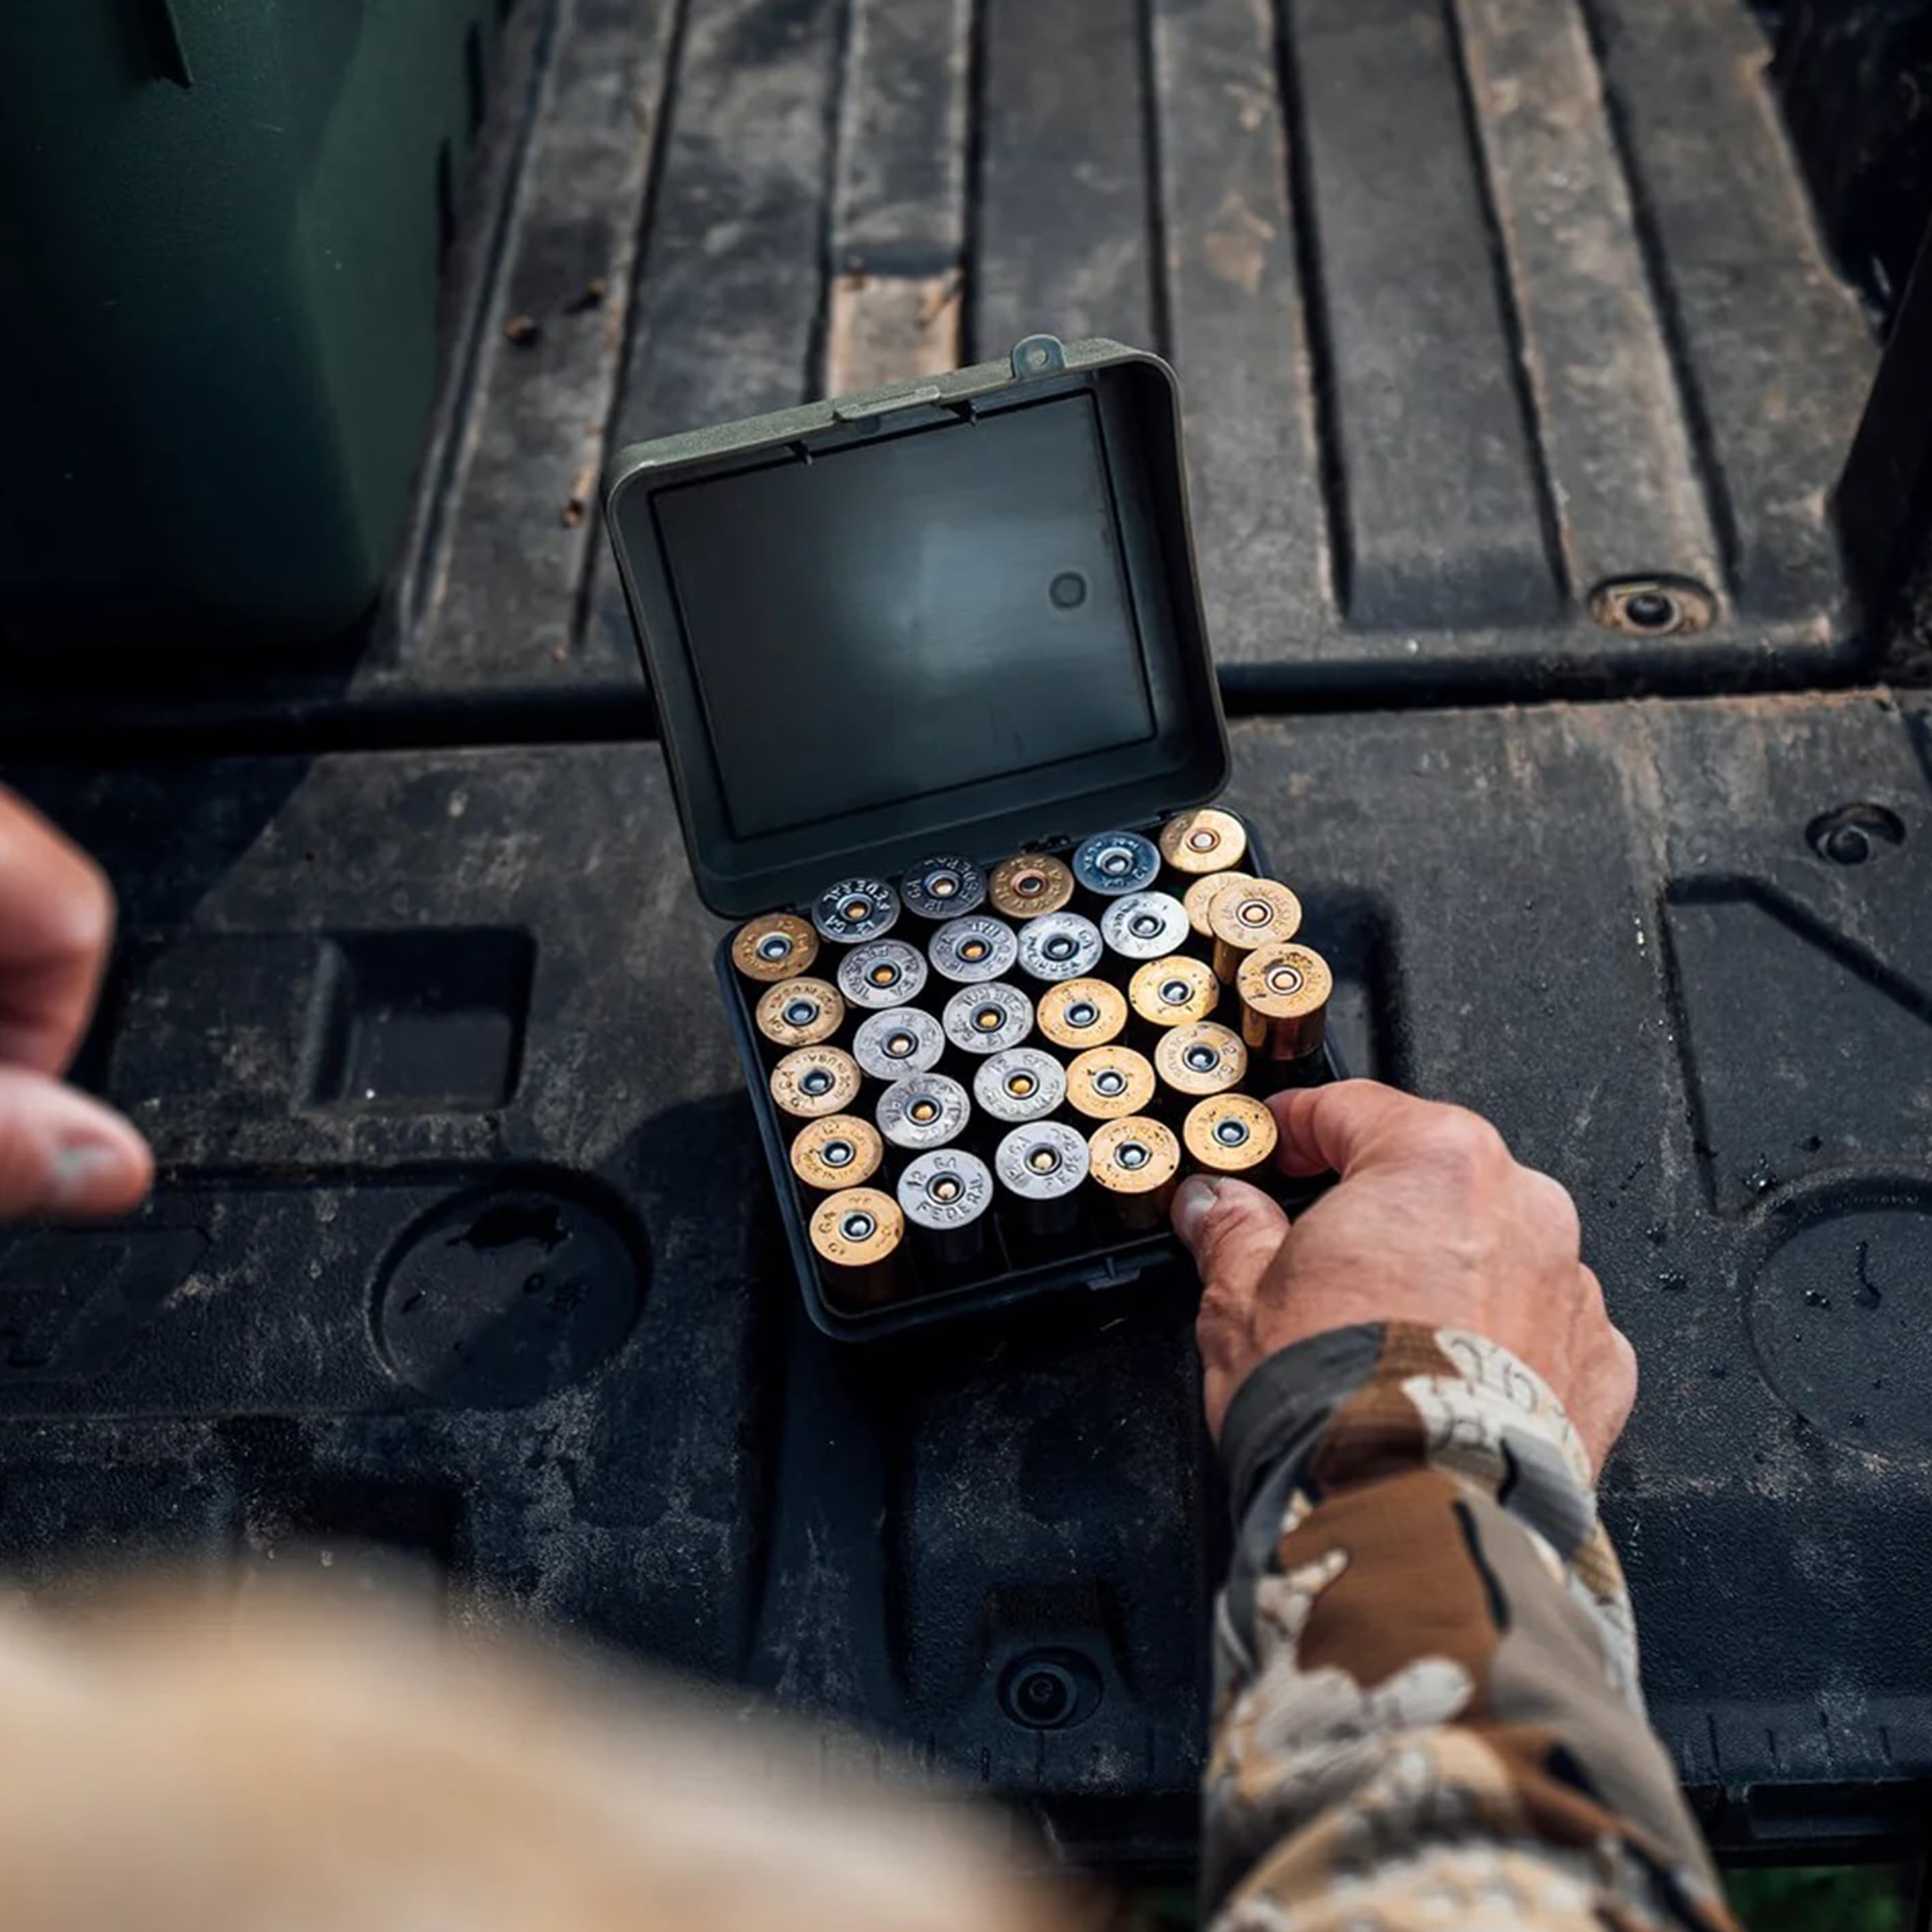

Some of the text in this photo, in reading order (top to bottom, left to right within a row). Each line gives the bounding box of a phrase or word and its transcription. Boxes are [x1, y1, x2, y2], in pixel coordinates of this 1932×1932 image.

[906, 1156, 956, 1187] 12 GA
[916, 1173, 983, 1221] FEDERAL
